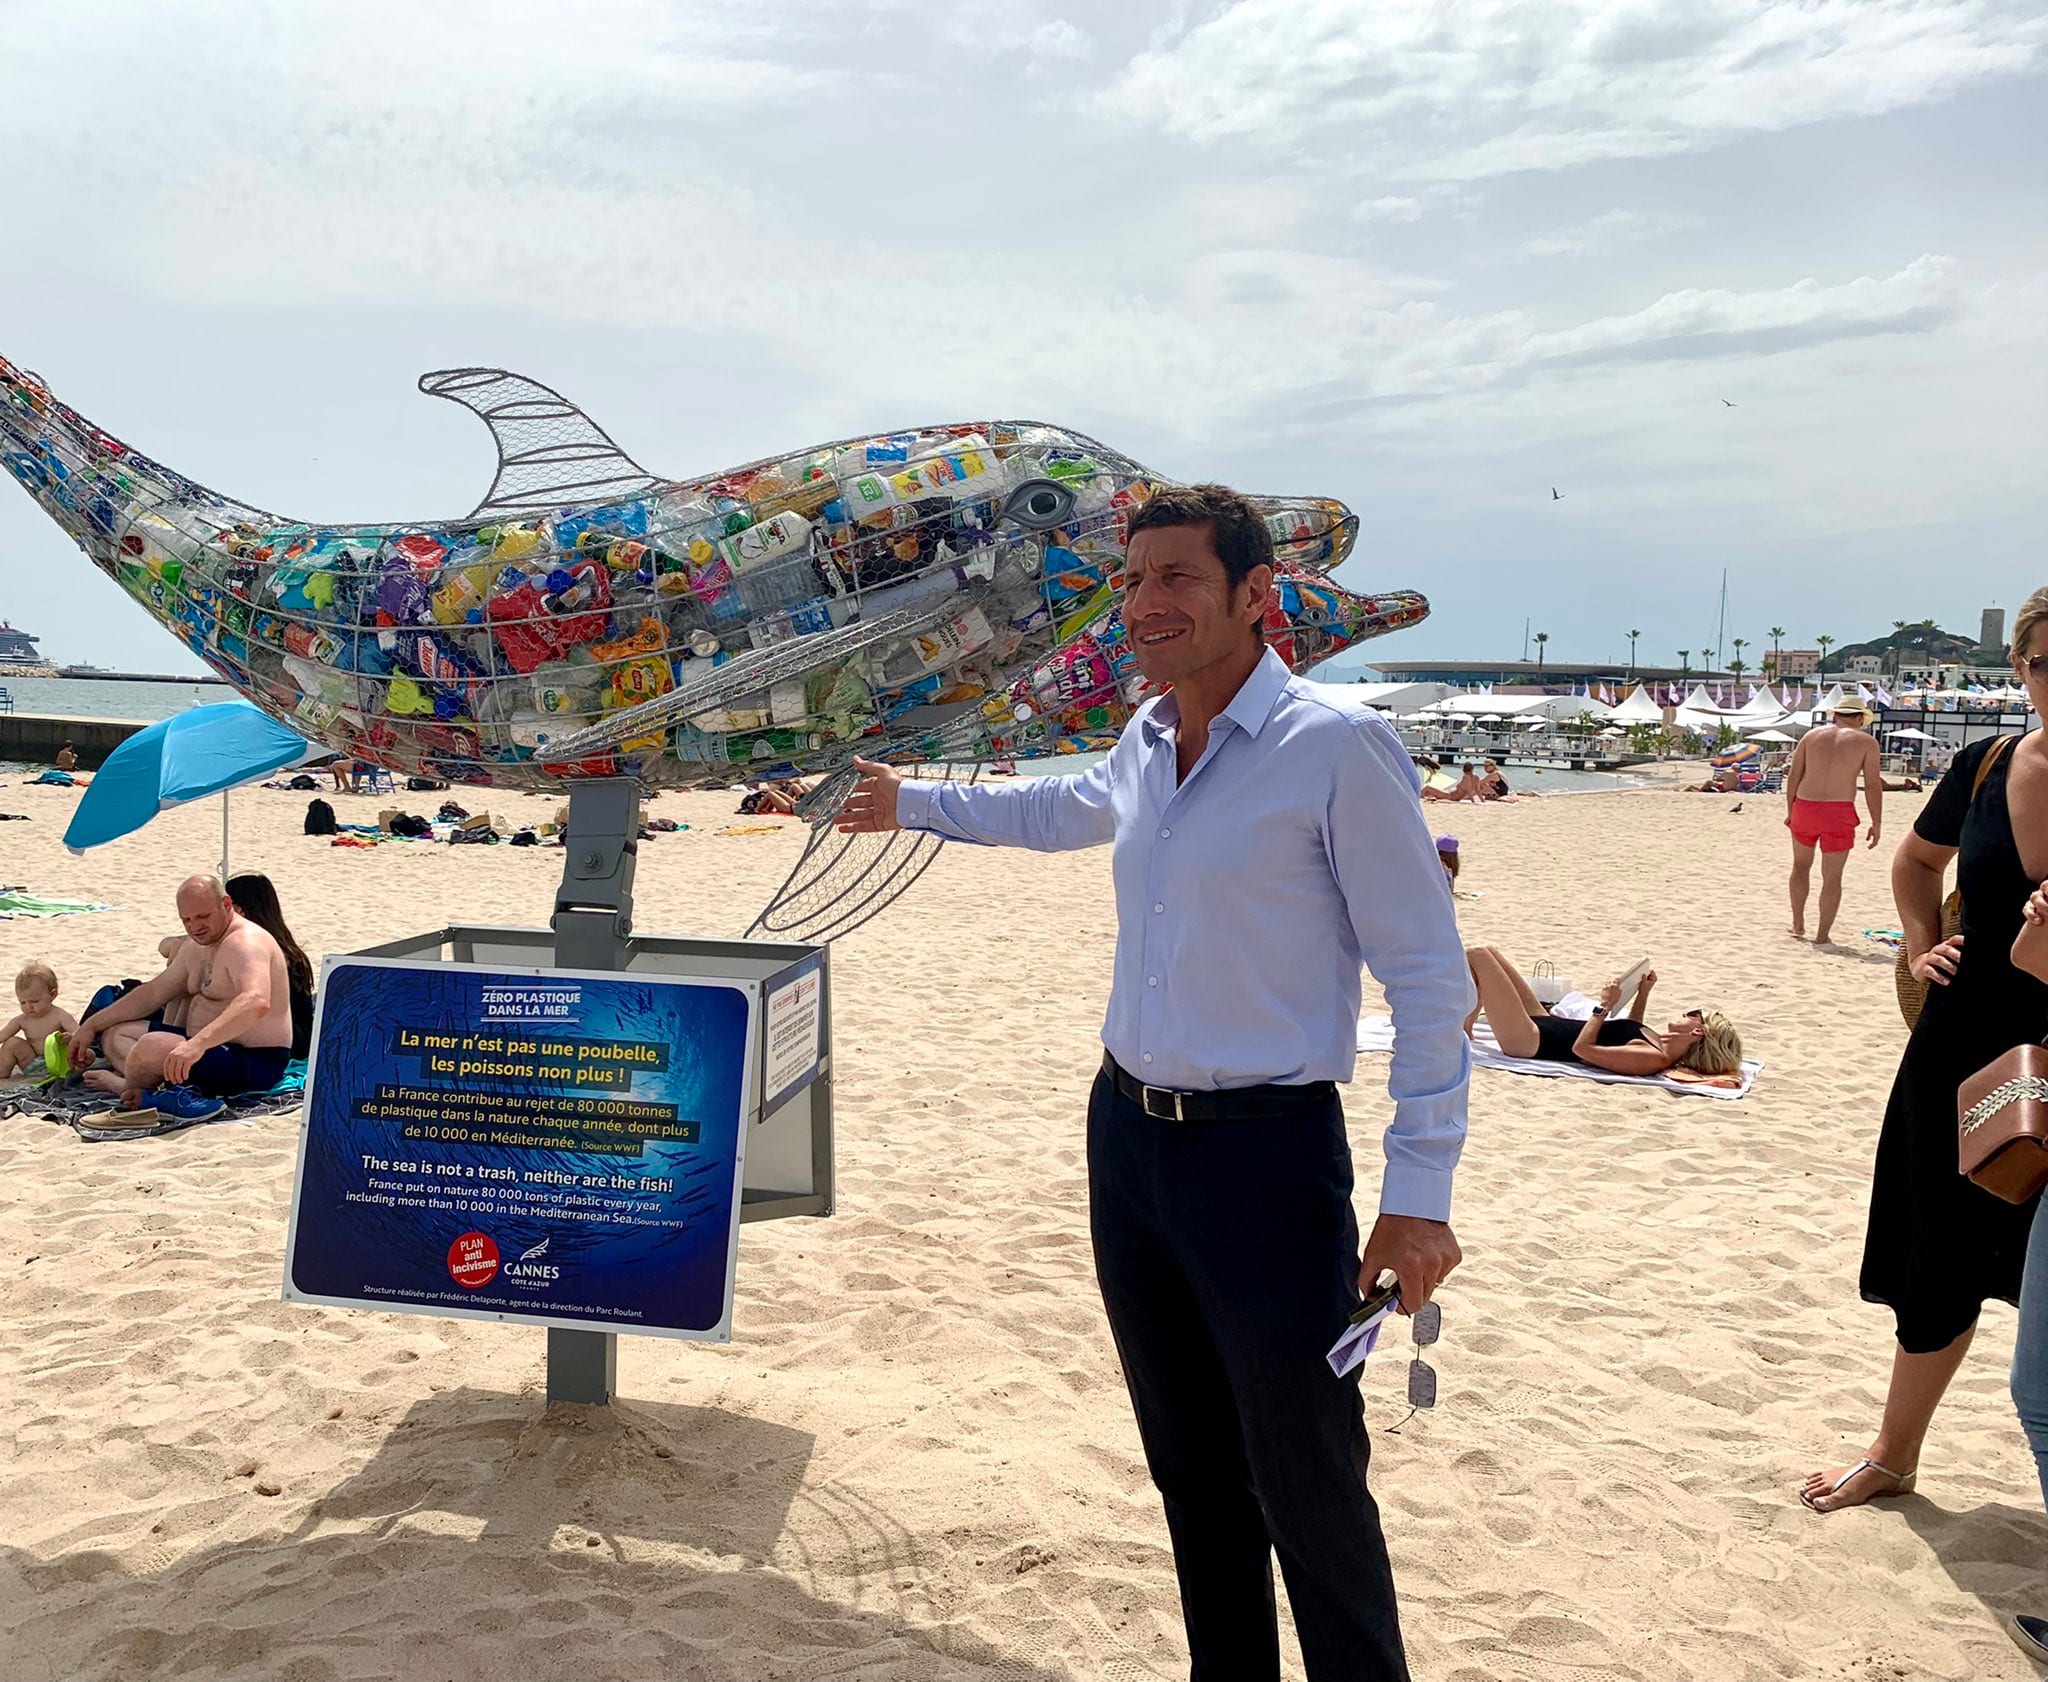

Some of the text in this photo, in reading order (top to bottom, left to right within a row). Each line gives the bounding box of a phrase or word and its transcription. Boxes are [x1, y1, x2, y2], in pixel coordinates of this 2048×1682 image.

[482, 990, 581, 1004] ZÉRO PLASTIQUE
[488, 1004, 569, 1016] DANS LA MER
[401, 1031, 419, 1047] La
[424, 1035, 458, 1049] mer
[508, 1041, 536, 1056] pas
[541, 1043, 573, 1056] une
[578, 1044, 660, 1065] poubelle,
[431, 1055, 624, 1084] les poissons non plus !
[382, 1086, 672, 1118] La France contribue au rejet de 80 000 tonnes
[362, 1102, 689, 1137] de plastique dans la nature chaque année, dont plus
[405, 1125, 640, 1153] de 10 000 en Méditerranée. (Source WWF)
[362, 1155, 673, 1192] The sea is not a trash, neither are the fish!
[346, 1191, 395, 1207] including
[398, 1196, 426, 1207] more
[428, 1197, 452, 1209] than
[456, 1199, 468, 1210] 10
[471, 1200, 493, 1213] 000
[496, 1203, 506, 1213] in
[510, 1204, 528, 1215] the
[530, 1206, 610, 1222] Mediterranean
[662, 1219, 683, 1228] WWF)
[368, 1178, 662, 1213] France put on nature 80 000 tons of plastic every year,
[460, 1238, 484, 1251] PLAN
[464, 1249, 482, 1261] anti
[452, 1259, 497, 1274] incivisme
[504, 1263, 559, 1279] CANNES
[363, 1284, 396, 1295] Structure
[397, 1287, 425, 1298] réalisée
[427, 1291, 439, 1299] par
[440, 1291, 469, 1302] Frédéric
[471, 1294, 507, 1306] Delaporte,
[509, 1300, 529, 1309] agent
[531, 1300, 541, 1309] de
[542, 1301, 548, 1309] la
[550, 1302, 583, 1312] direction
[584, 1305, 595, 1313] du
[596, 1306, 612, 1315] Parc
